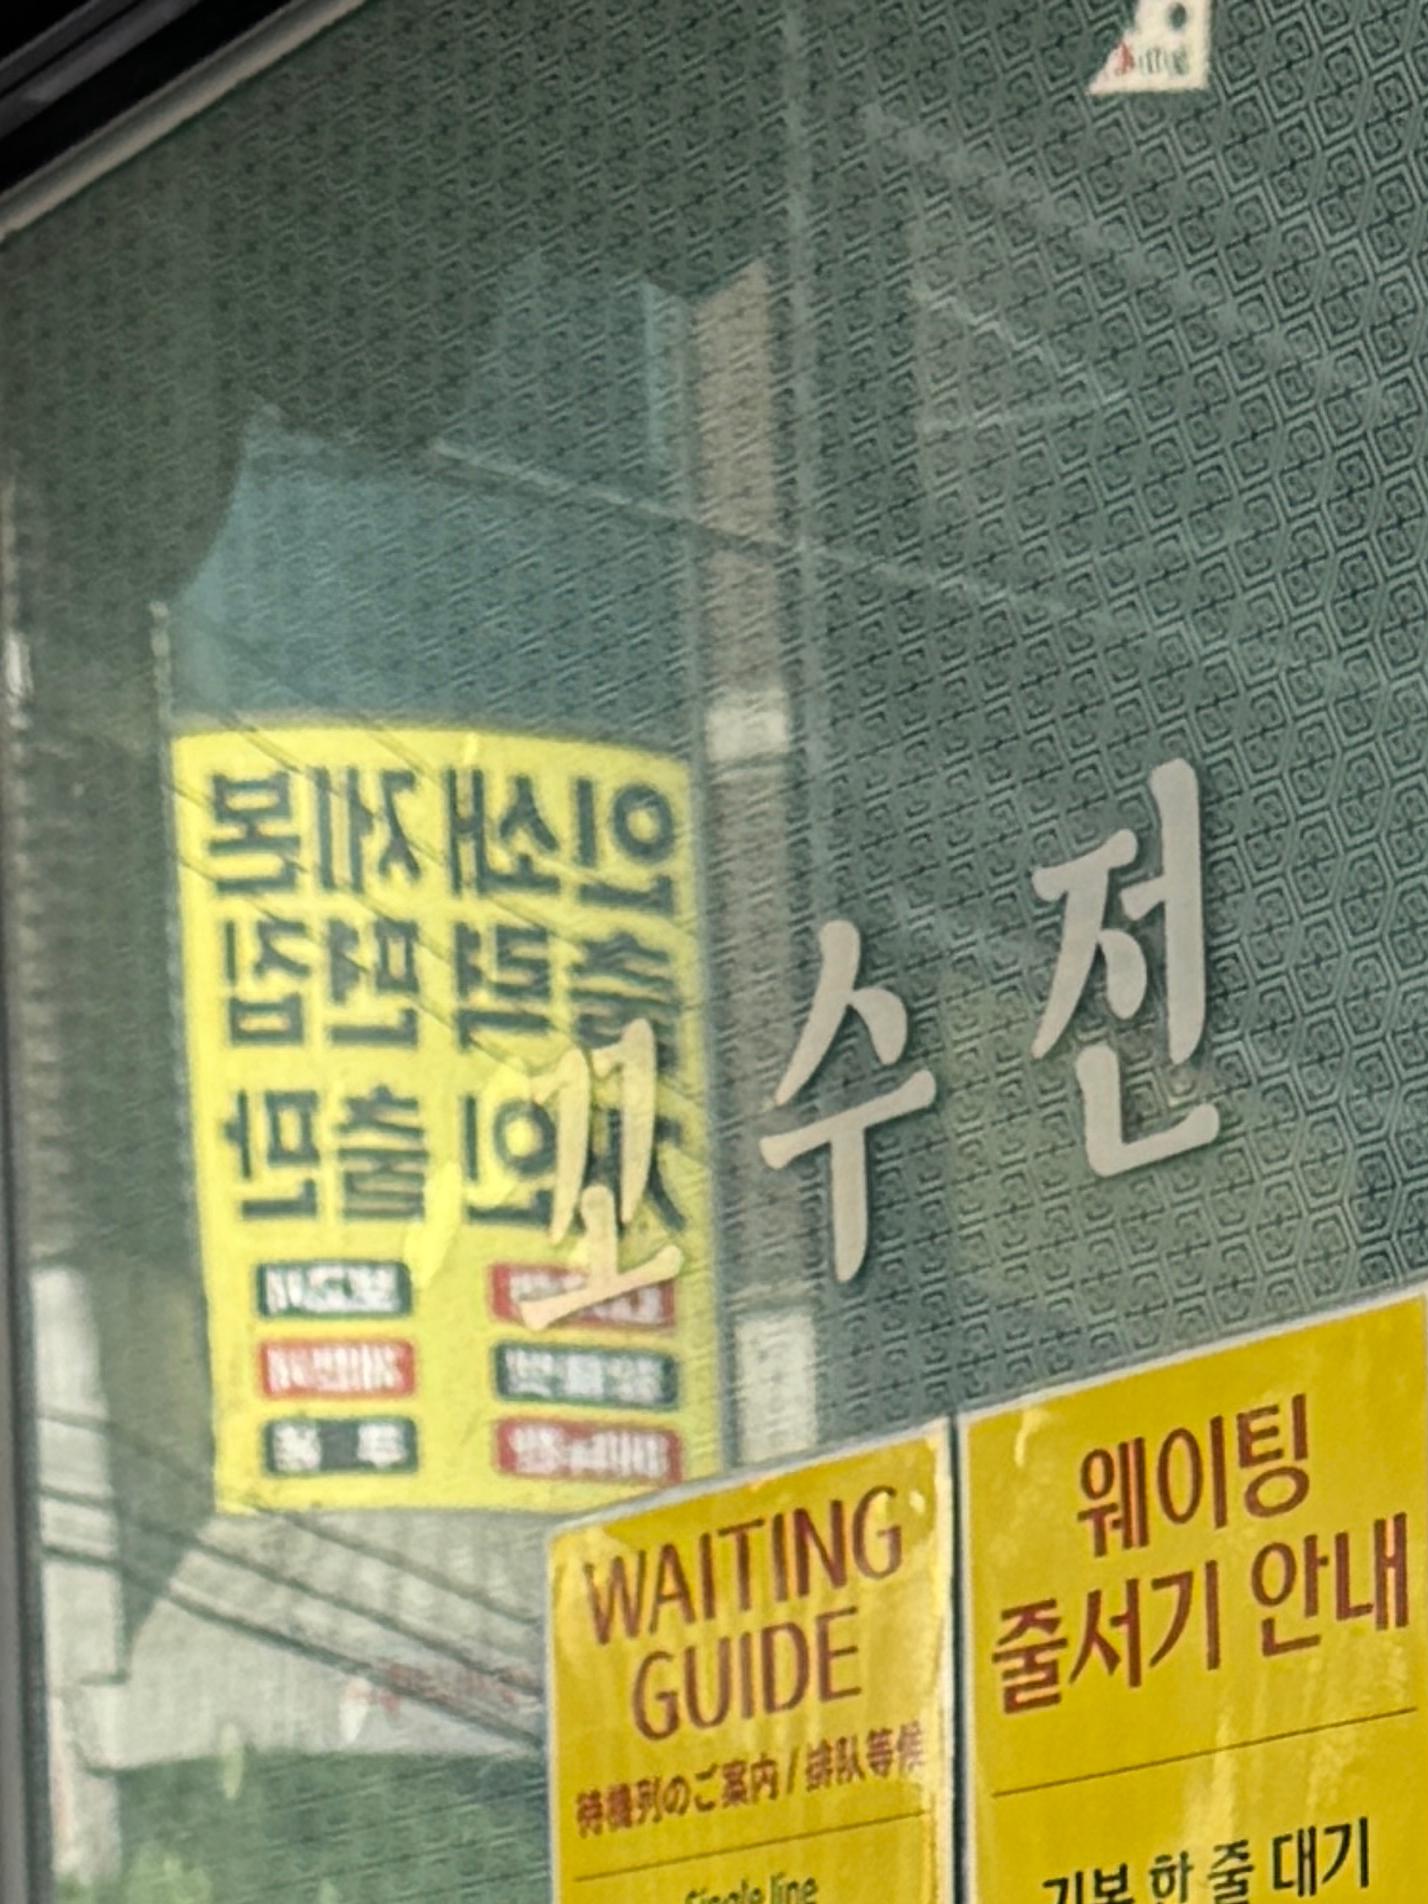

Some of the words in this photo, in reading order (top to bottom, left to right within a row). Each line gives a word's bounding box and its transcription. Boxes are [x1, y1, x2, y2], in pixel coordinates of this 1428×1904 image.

[1077, 1393, 1312, 1559] 웨이팅
[585, 1485, 902, 1646] WAITING
[991, 1558, 1222, 1716] 줄서기
[1250, 1511, 1411, 1659] 안내
[632, 1605, 863, 1742] GUIDE
[1272, 1816, 1370, 1898] 대기
